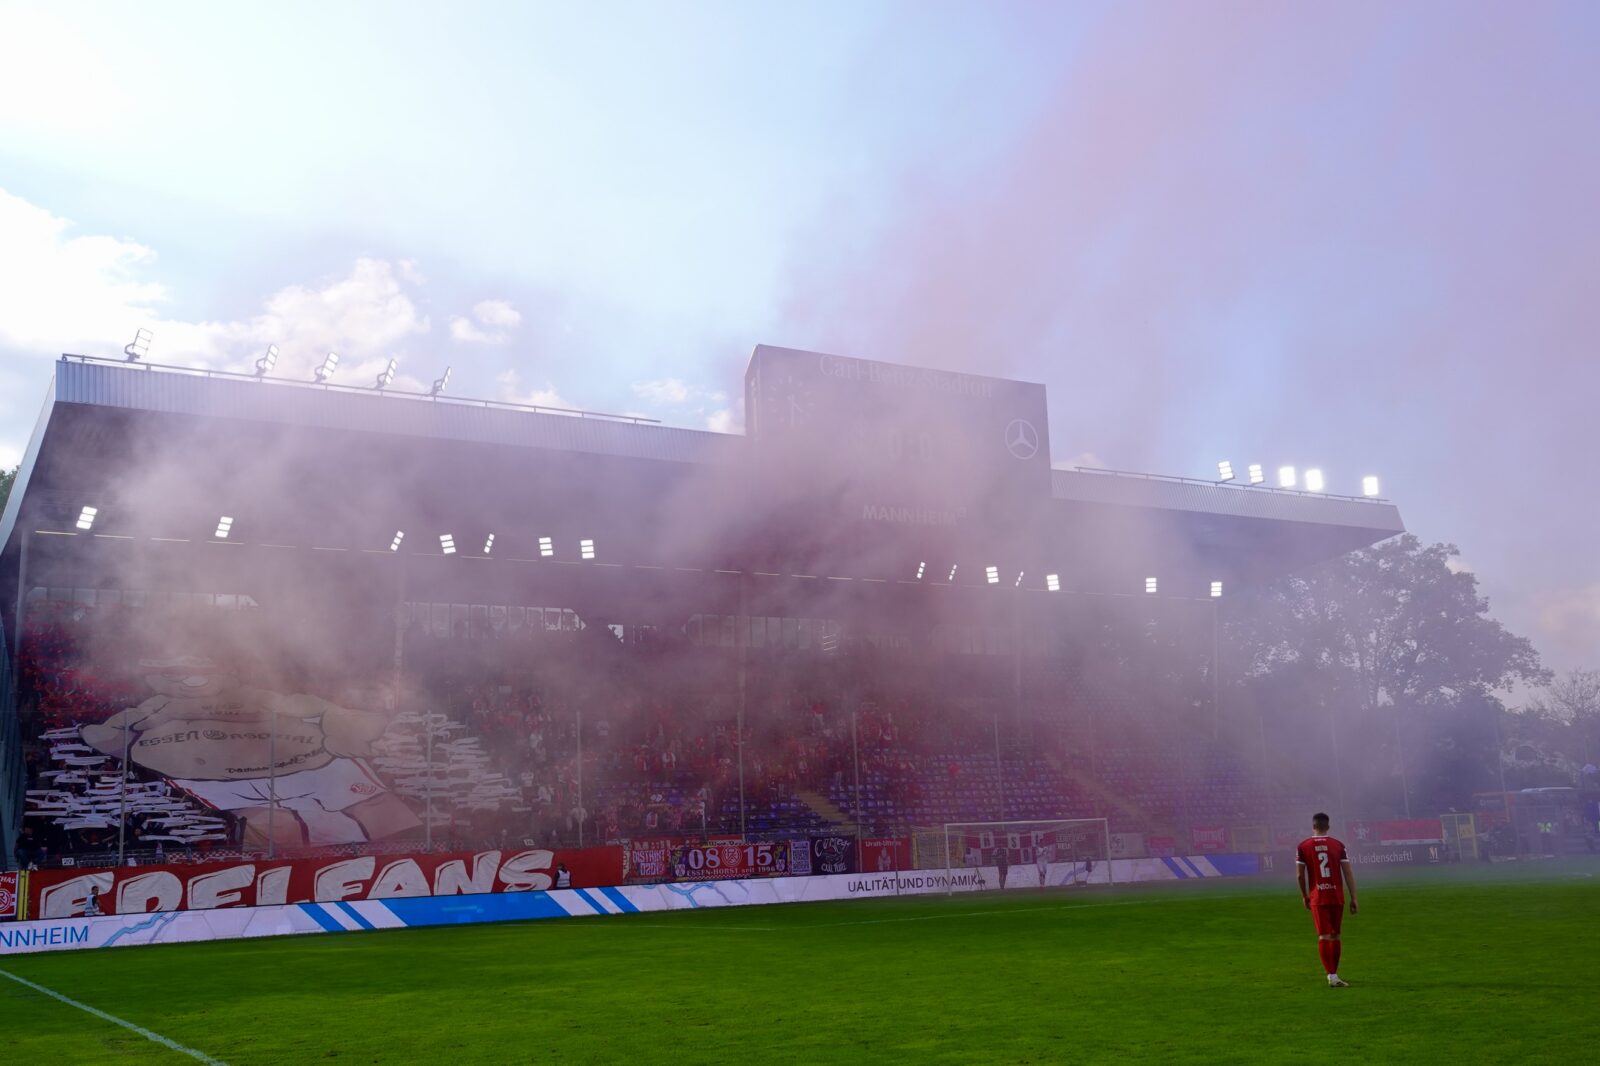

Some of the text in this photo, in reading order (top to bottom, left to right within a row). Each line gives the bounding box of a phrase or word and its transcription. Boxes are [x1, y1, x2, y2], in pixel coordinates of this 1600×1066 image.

[688, 847, 720, 870] 08
[743, 845, 773, 867] 15
[1318, 852, 1331, 878] 2
[1359, 851, 1413, 864] Leidenschaft!
[898, 877, 924, 889] UND
